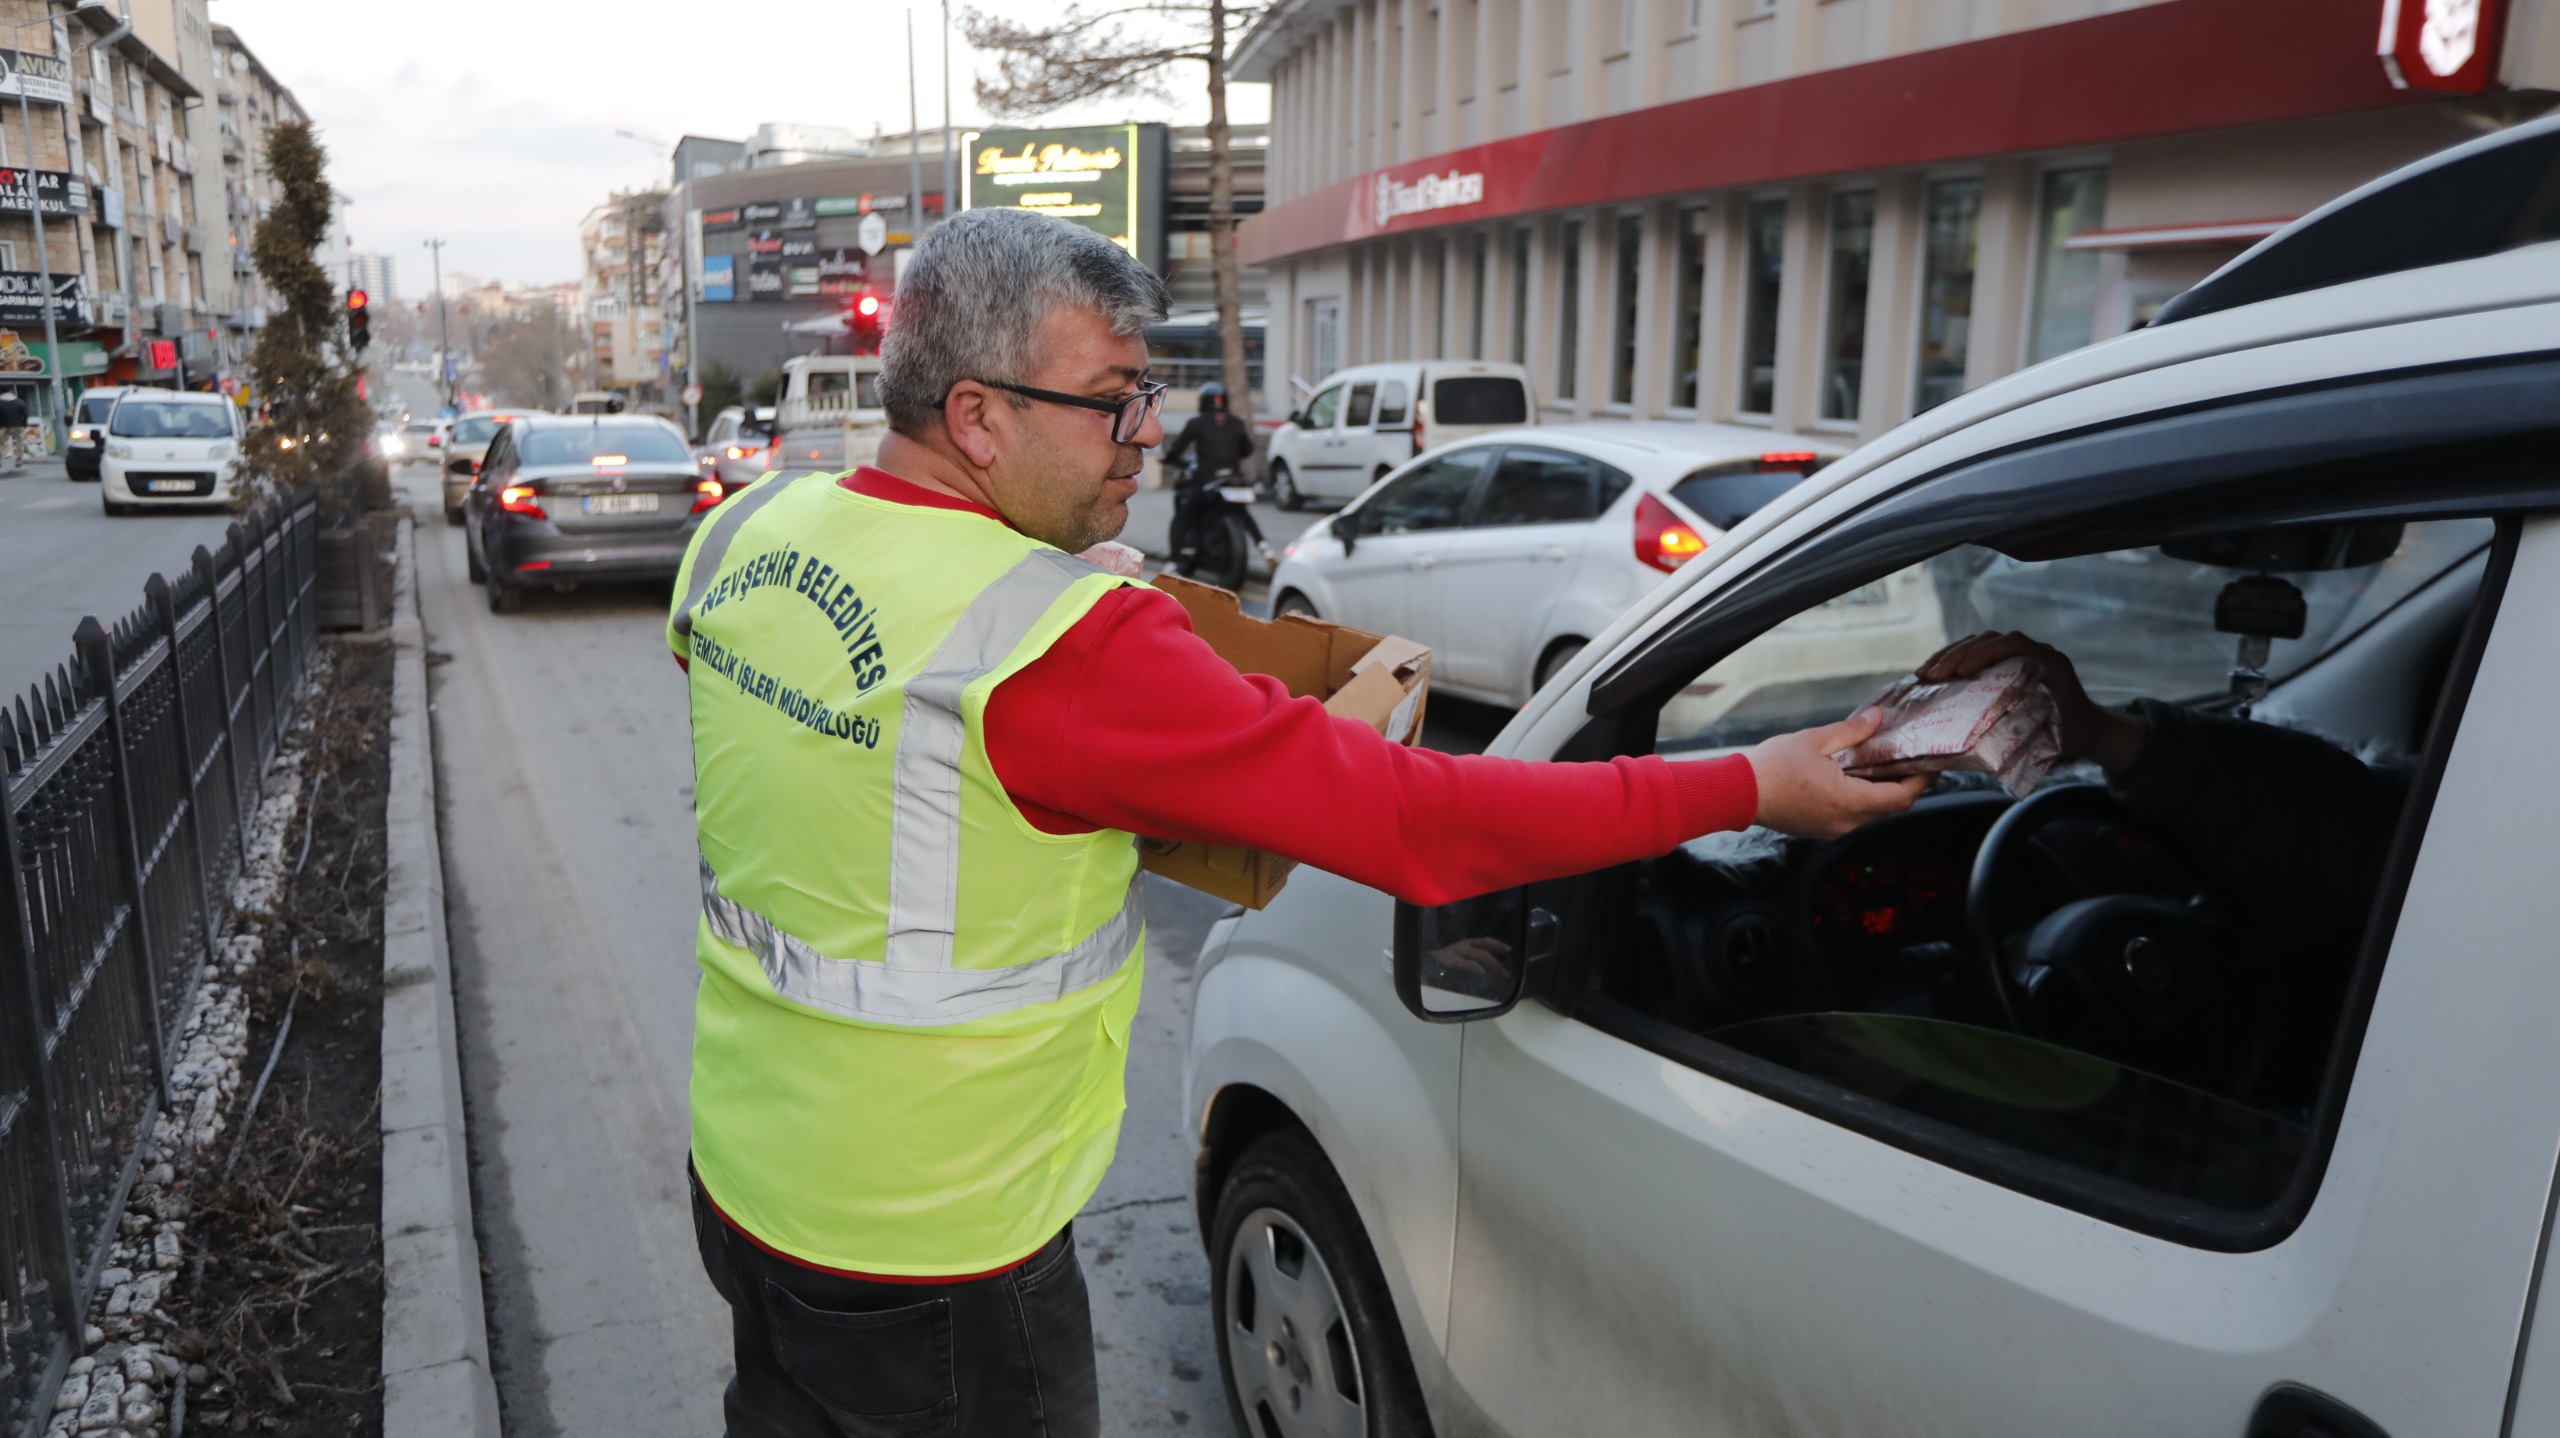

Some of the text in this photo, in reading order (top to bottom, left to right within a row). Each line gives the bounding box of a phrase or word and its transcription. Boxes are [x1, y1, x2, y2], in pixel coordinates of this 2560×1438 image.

[691, 630, 880, 750] TEMİZLİK İŞLERİ MÜDÜRLÜĞÜ
[700, 542, 888, 700] NEVŞEHİR BELEDİYES
